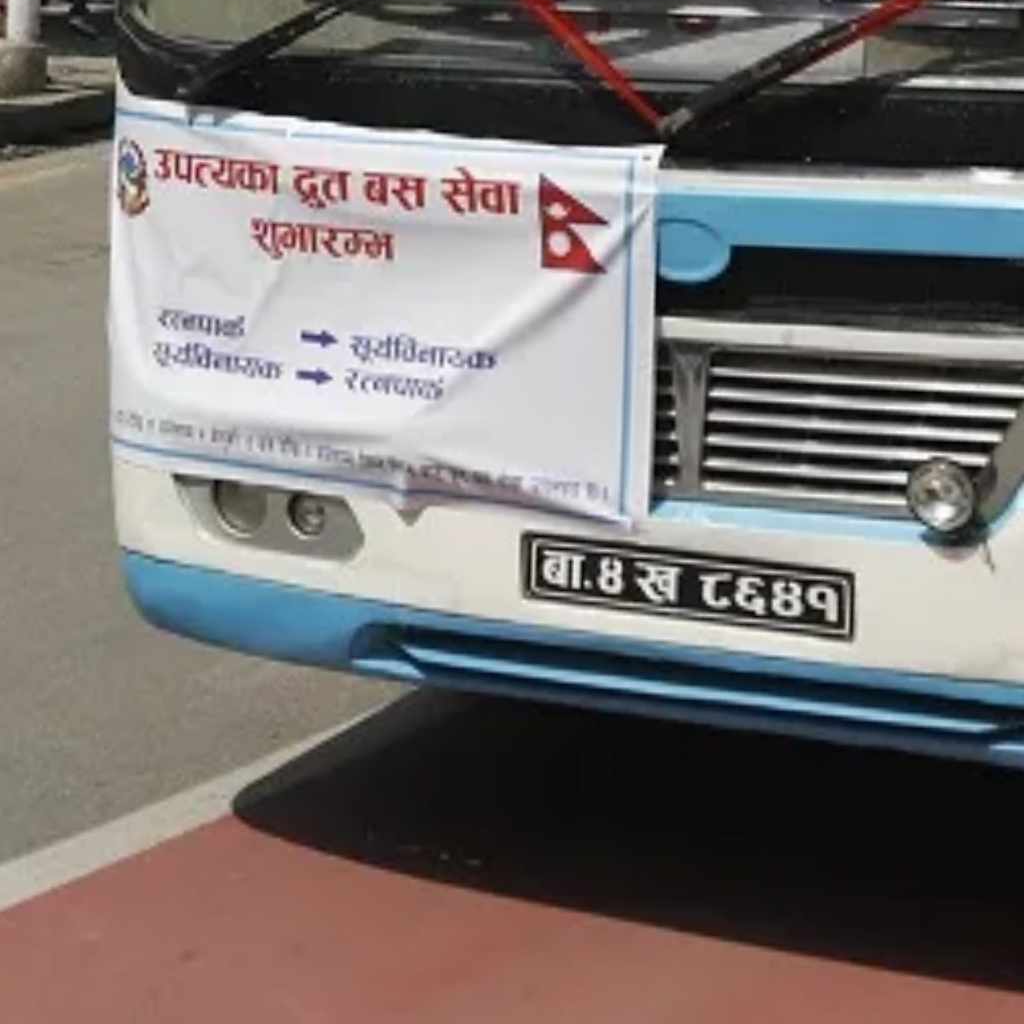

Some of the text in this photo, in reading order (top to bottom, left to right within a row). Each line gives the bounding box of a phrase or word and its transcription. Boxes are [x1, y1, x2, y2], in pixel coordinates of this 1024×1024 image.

[154, 148, 279, 195] उपत्यका
[363, 170, 428, 212] बस
[441, 167, 521, 217] सेवा
[700, 572, 840, 623] ८६४१
